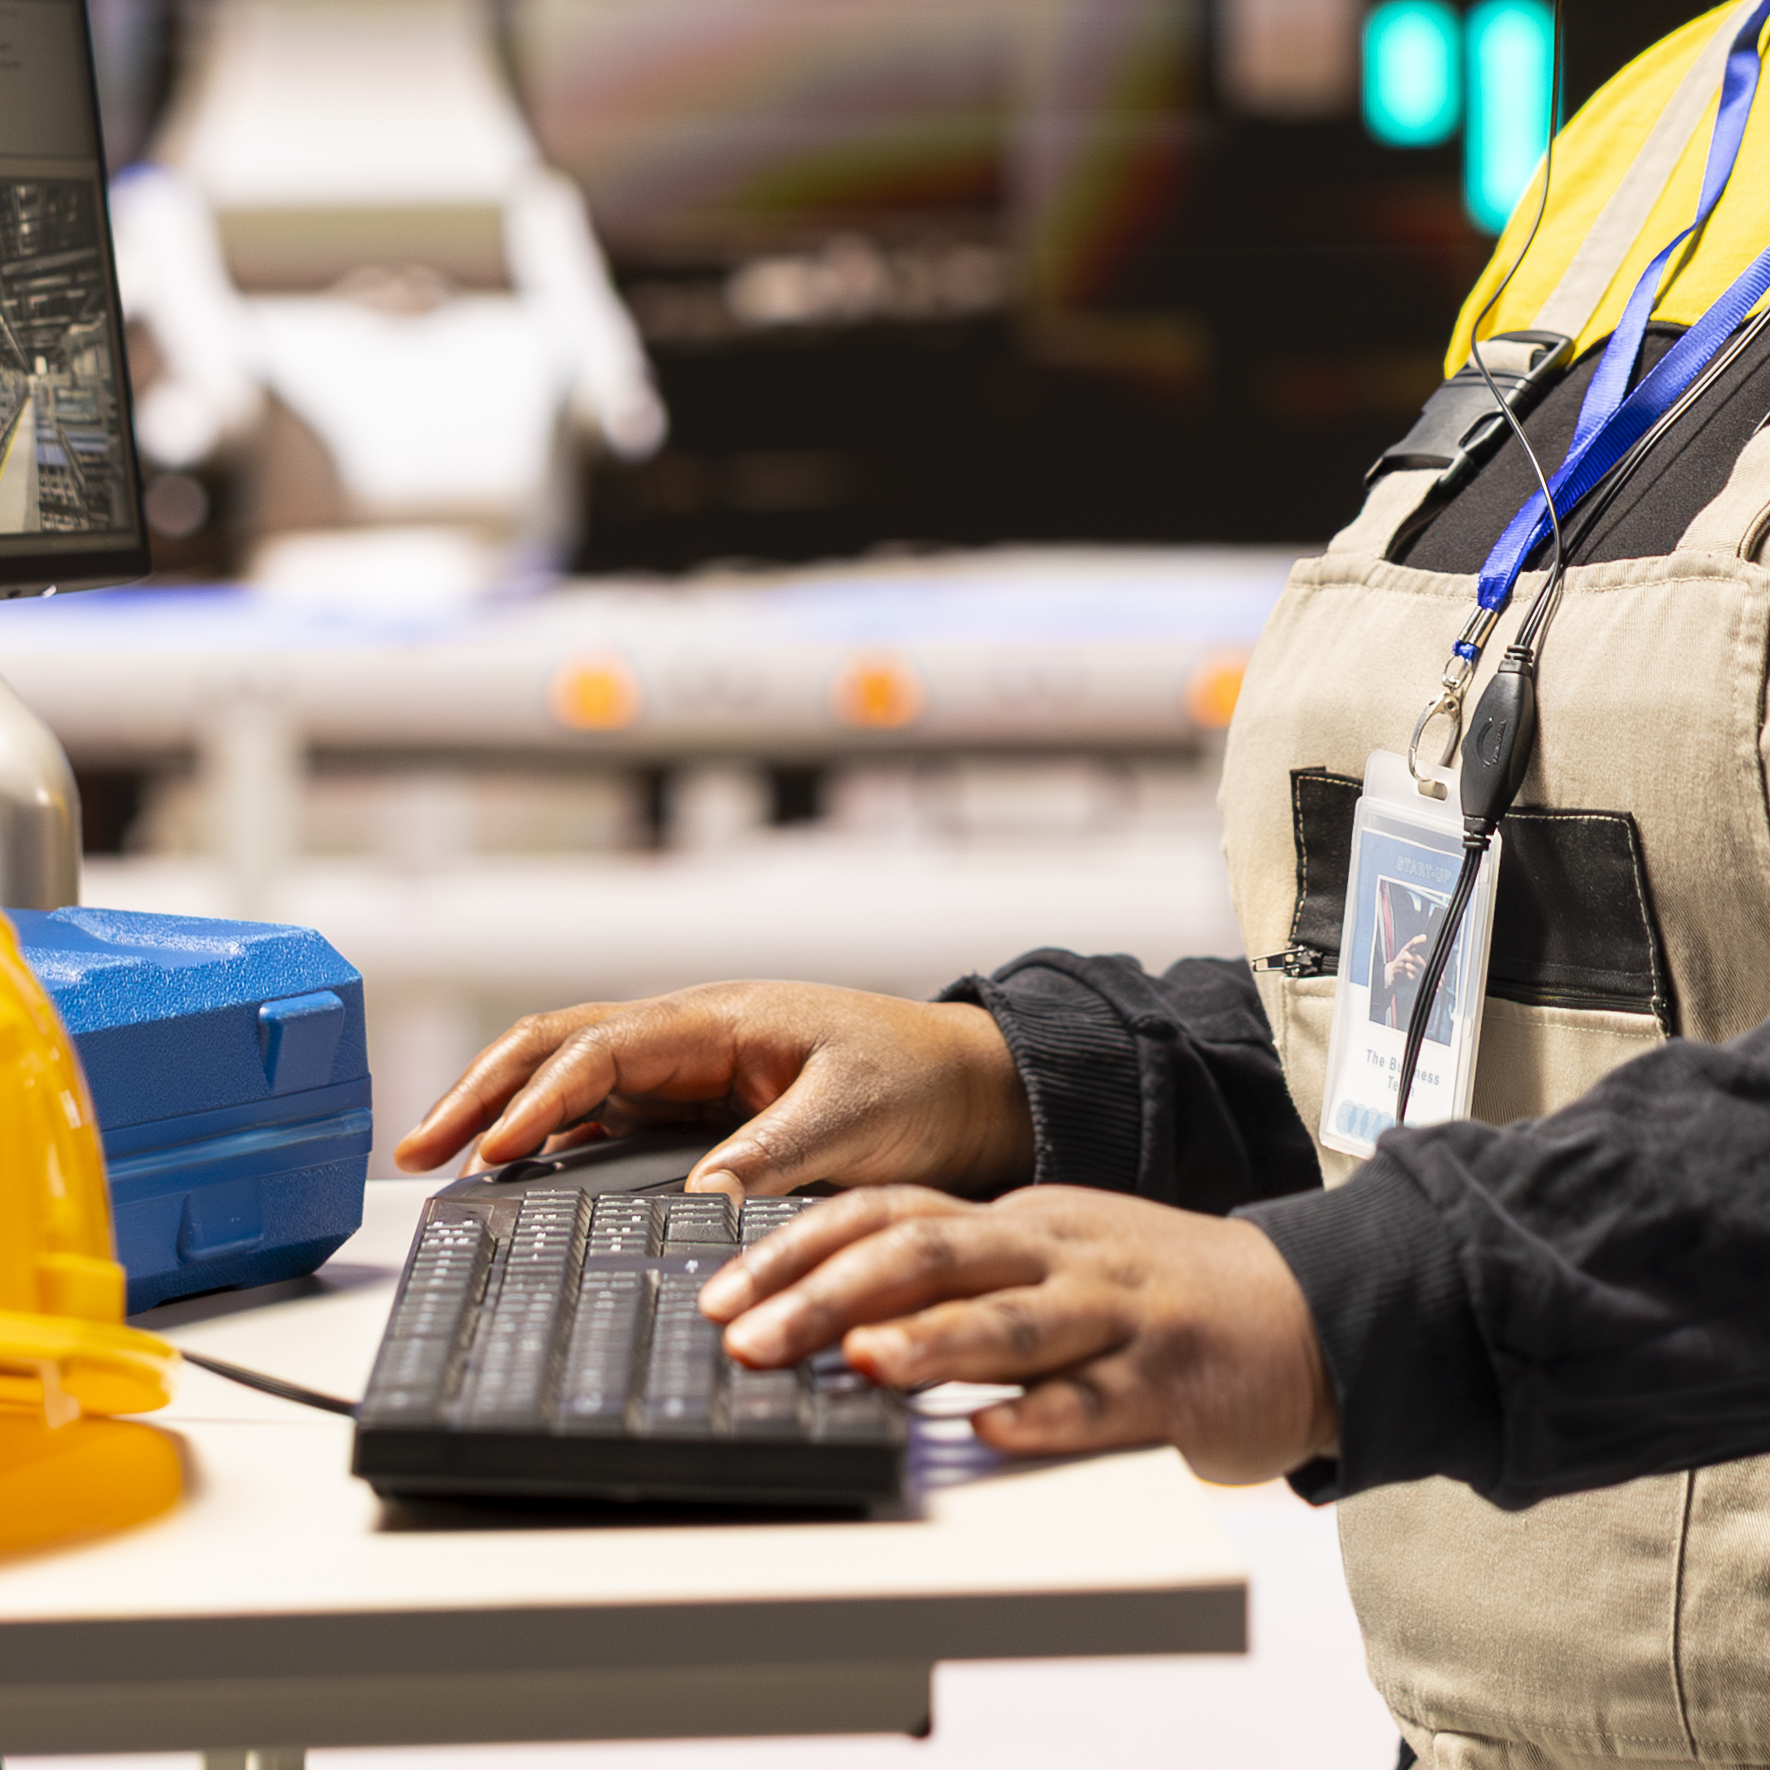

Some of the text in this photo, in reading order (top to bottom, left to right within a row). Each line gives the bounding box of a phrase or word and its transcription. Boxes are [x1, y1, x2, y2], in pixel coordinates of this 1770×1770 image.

[1395, 854, 1452, 884] START-UP
[1366, 1048, 1441, 1086] The Buness
